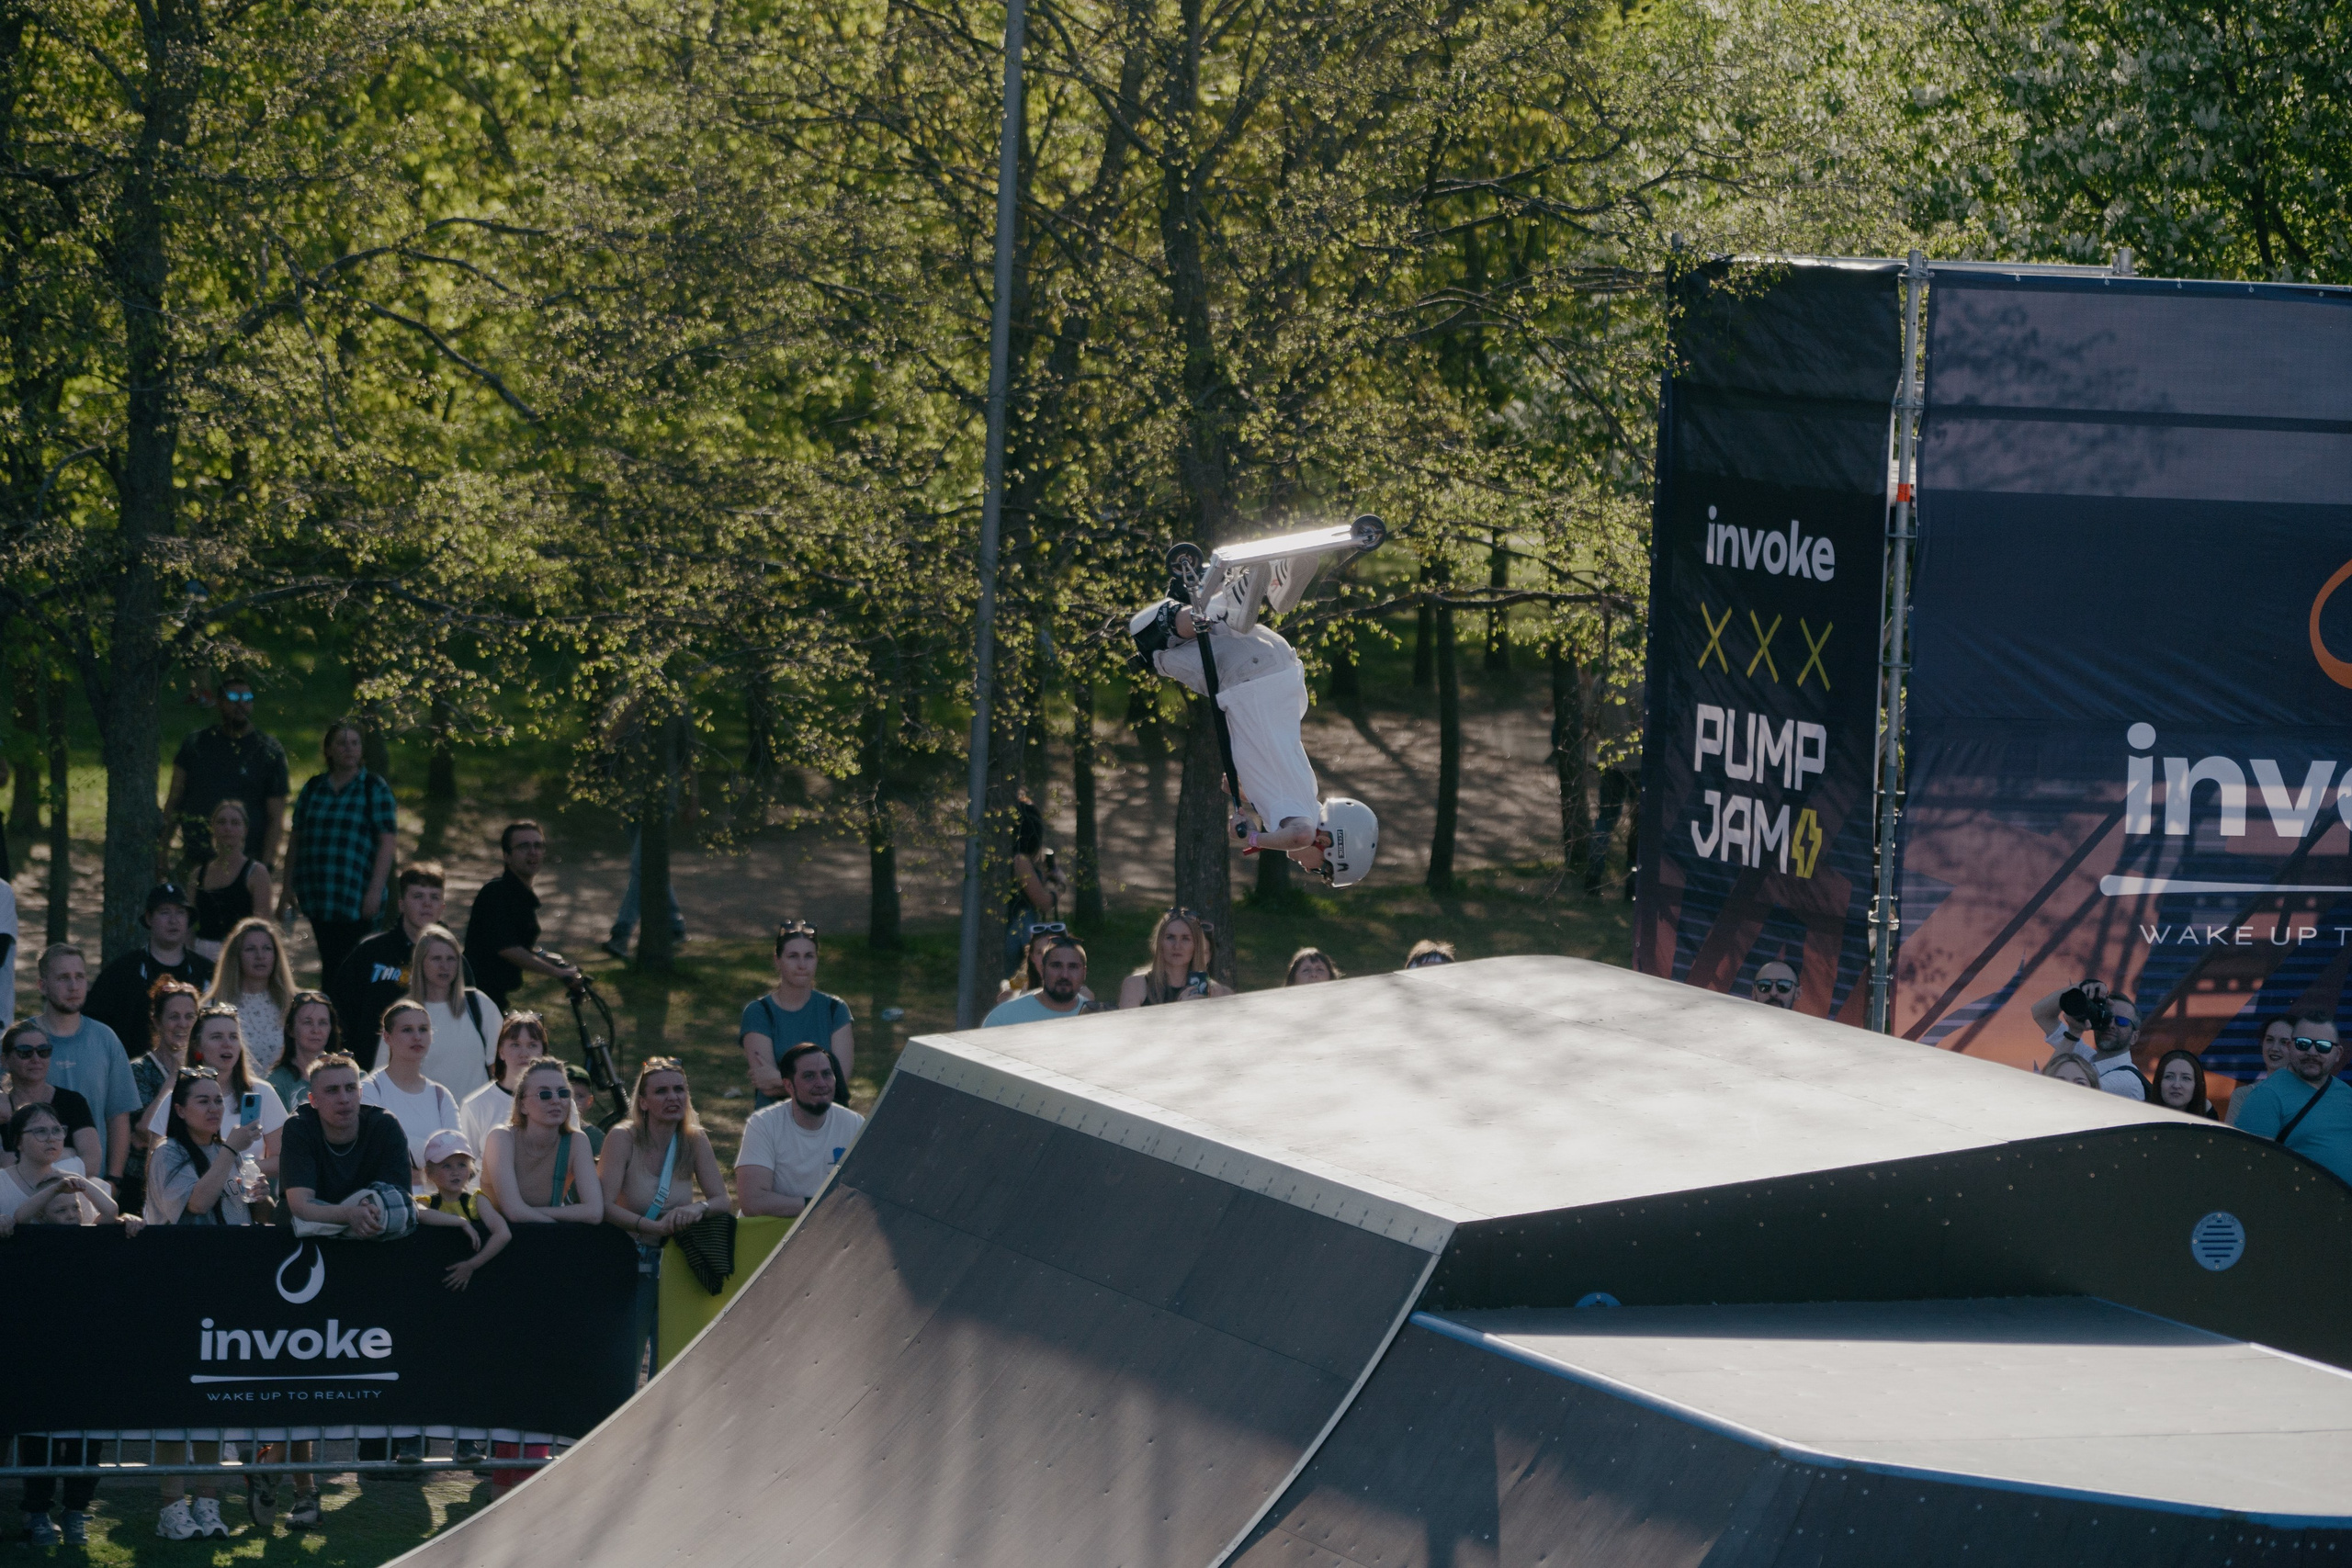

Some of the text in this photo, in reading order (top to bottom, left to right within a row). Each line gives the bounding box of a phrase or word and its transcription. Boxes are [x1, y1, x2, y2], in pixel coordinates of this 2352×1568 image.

[1706, 505, 1835, 581] invoke
[1694, 703, 1827, 792] PUMP
[2139, 924, 2255, 946] WAKE
[2270, 925, 2317, 946] UP
[200, 1317, 393, 1360] invoke
[207, 1390, 382, 1402] WAKE UP TO REALITY
